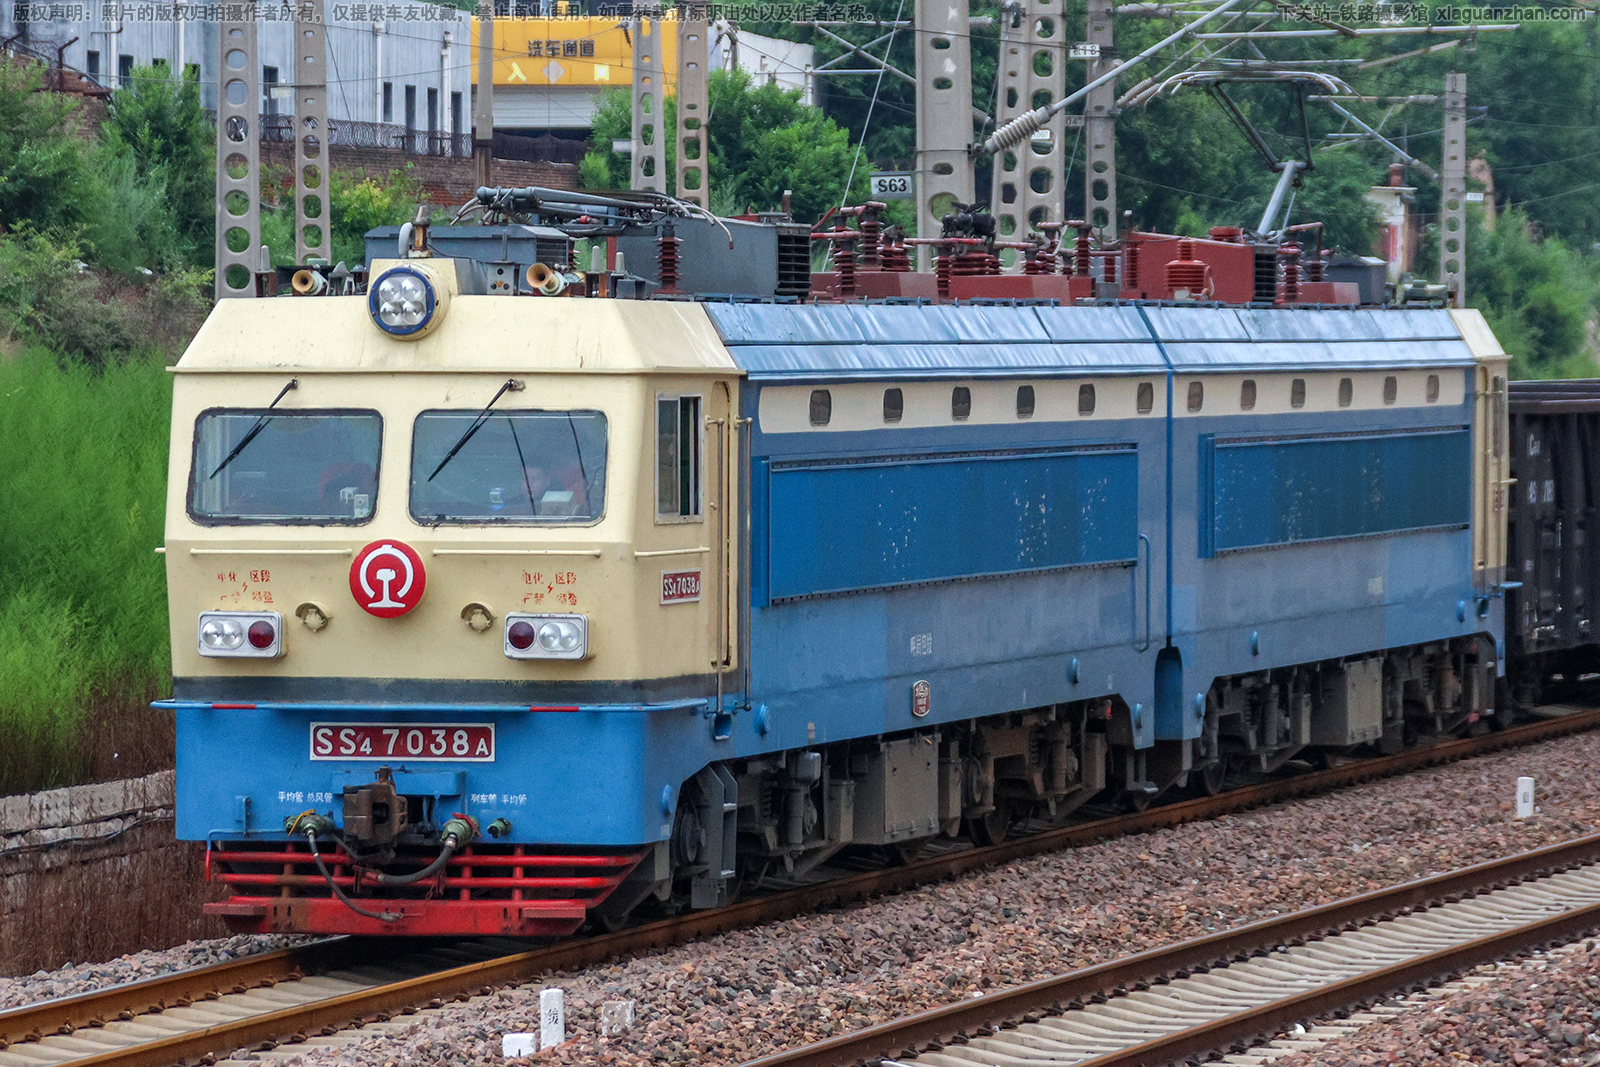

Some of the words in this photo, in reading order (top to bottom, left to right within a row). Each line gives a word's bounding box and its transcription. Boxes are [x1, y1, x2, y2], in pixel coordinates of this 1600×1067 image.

[528, 39, 595, 57] 洗车通道
[507, 61, 527, 82] 入
[878, 178, 907, 193] S63
[278, 790, 303, 803] 平均管
